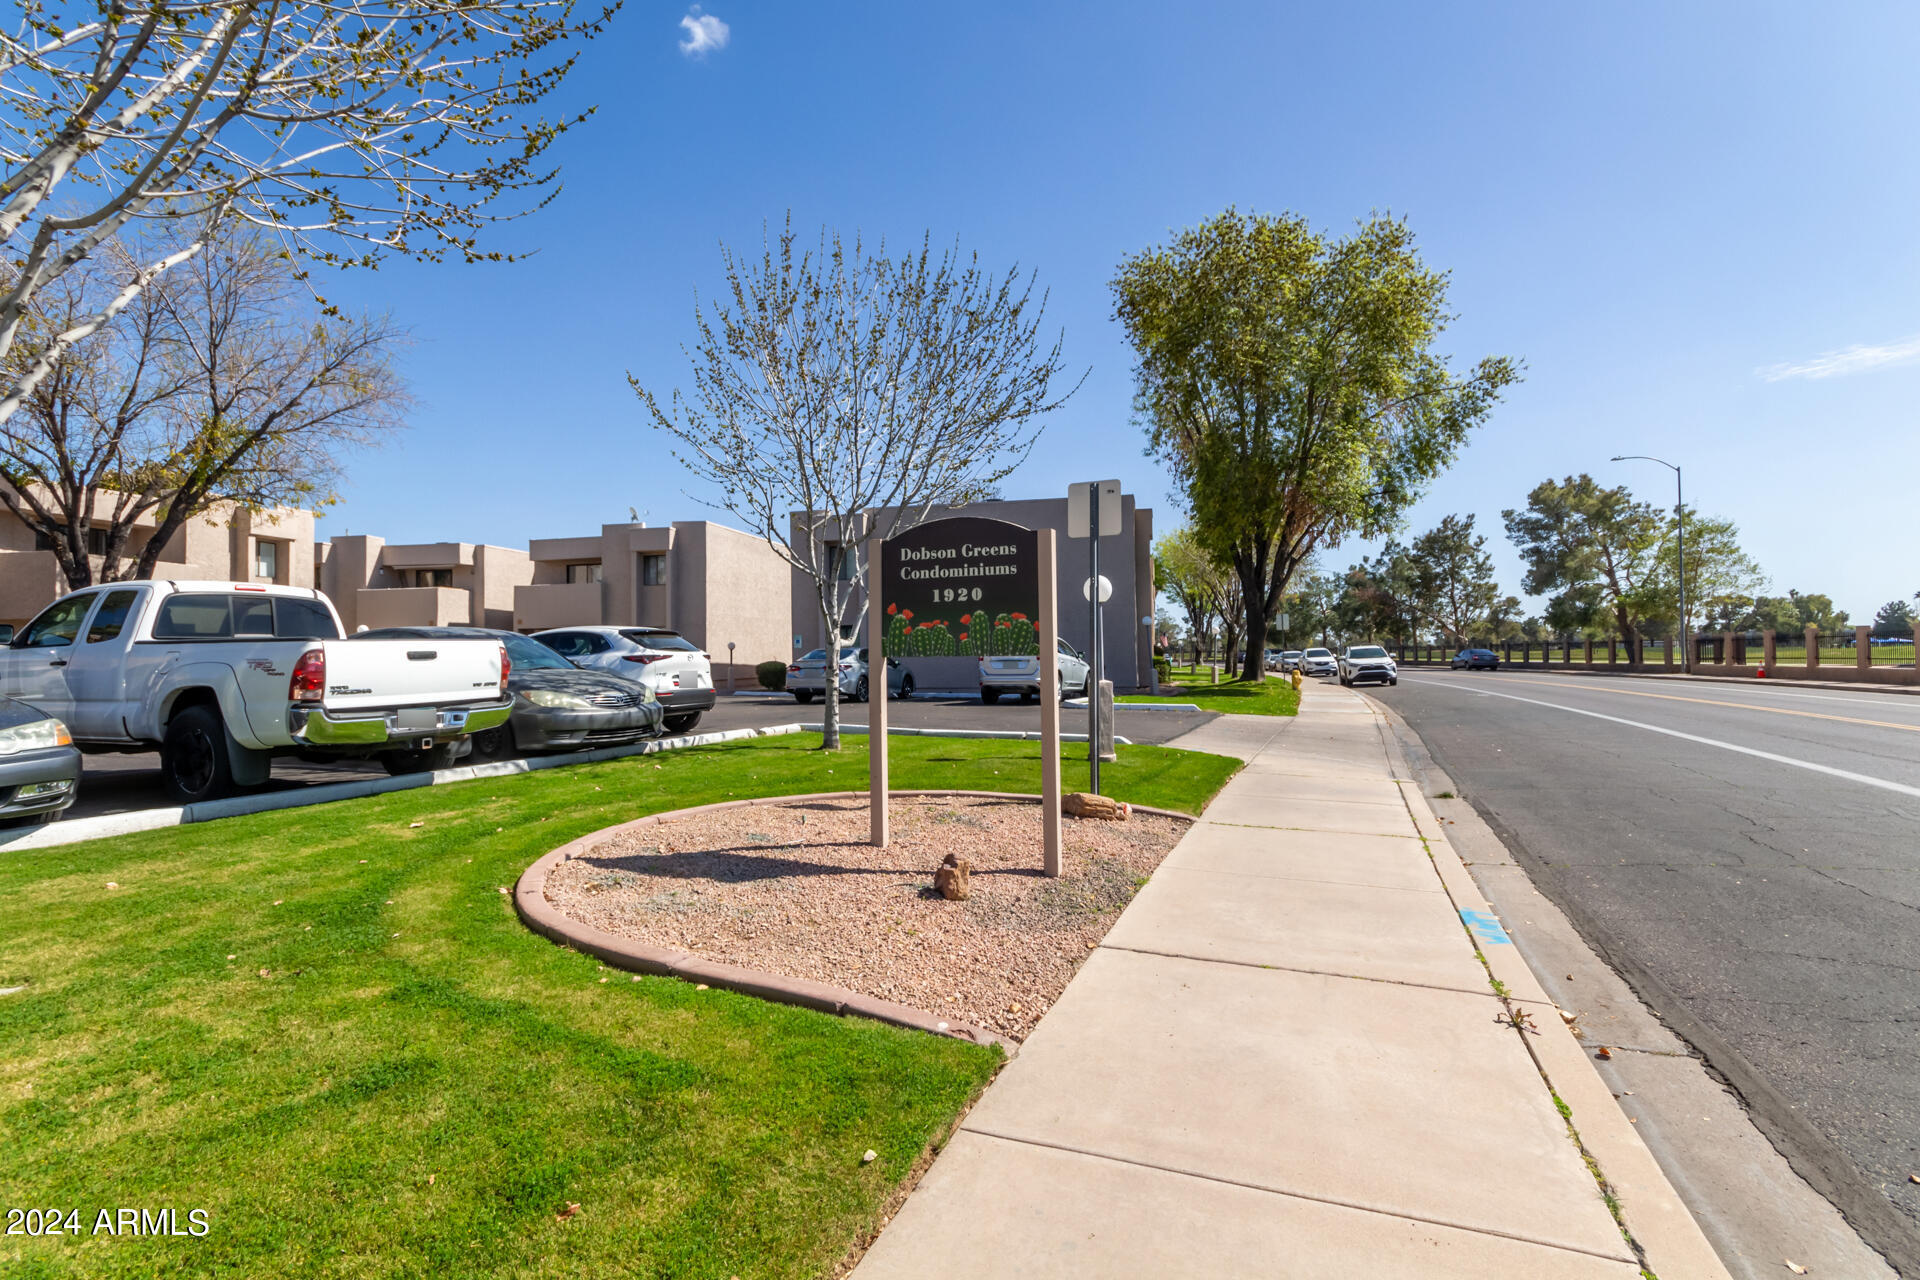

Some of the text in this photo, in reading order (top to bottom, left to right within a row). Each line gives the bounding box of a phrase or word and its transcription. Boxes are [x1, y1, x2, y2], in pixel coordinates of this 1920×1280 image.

[900, 543, 1017, 562] Dobson Greens
[900, 562, 1018, 580] Condominiums
[932, 587, 983, 603] 1920
